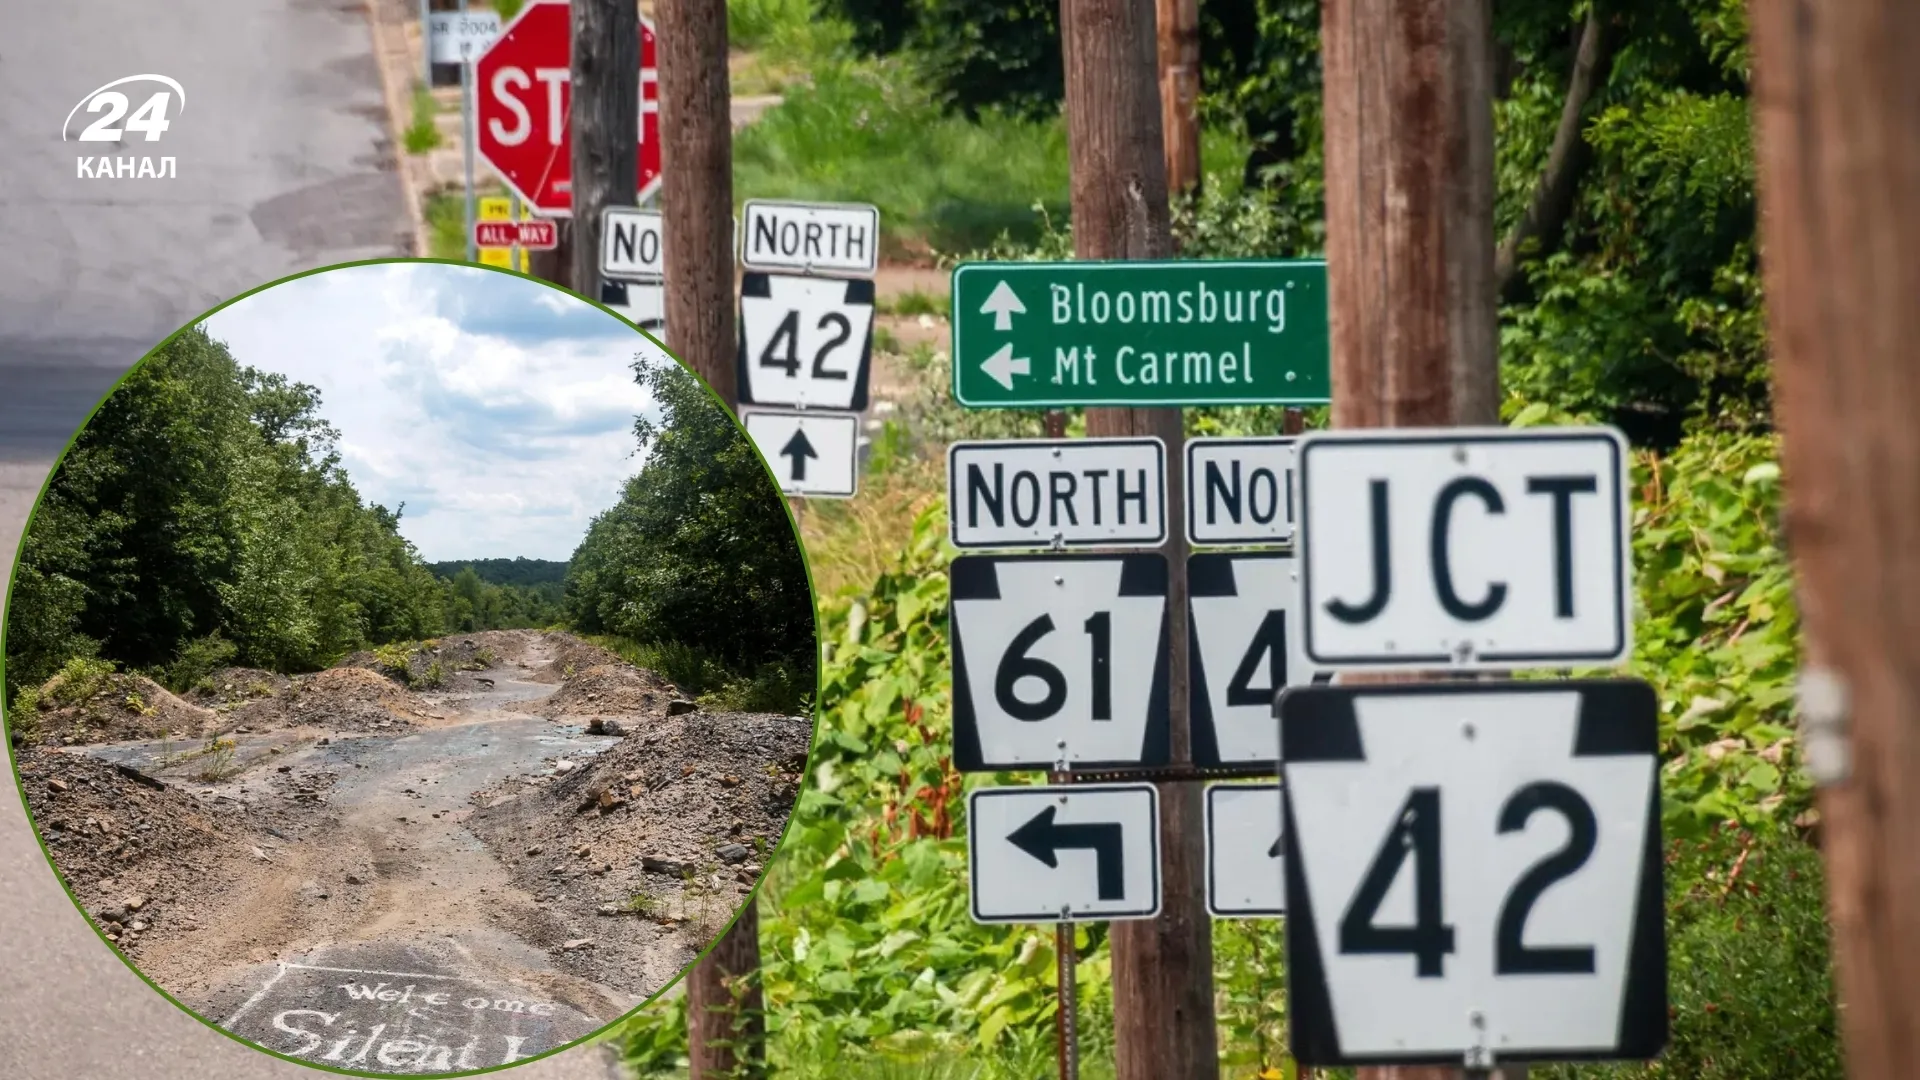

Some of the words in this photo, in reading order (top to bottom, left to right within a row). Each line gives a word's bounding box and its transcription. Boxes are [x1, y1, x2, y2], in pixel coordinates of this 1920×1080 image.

[488, 65, 659, 147] STP
[482, 226, 507, 242] ALL
[518, 226, 549, 243] WAY
[613, 222, 661, 265] NO
[754, 214, 865, 260] NORTH
[1050, 281, 1287, 333] Bloomsburg
[759, 309, 852, 381] 42
[1054, 346, 1098, 385] Mt
[1114, 342, 1254, 385] Carmel
[967, 462, 1149, 528] NORTH
[1205, 460, 1295, 527] NO
[1324, 474, 1598, 625] JCT
[994, 610, 1113, 723] 61
[1226, 608, 1291, 720] 4
[1337, 780, 1599, 978] 42
